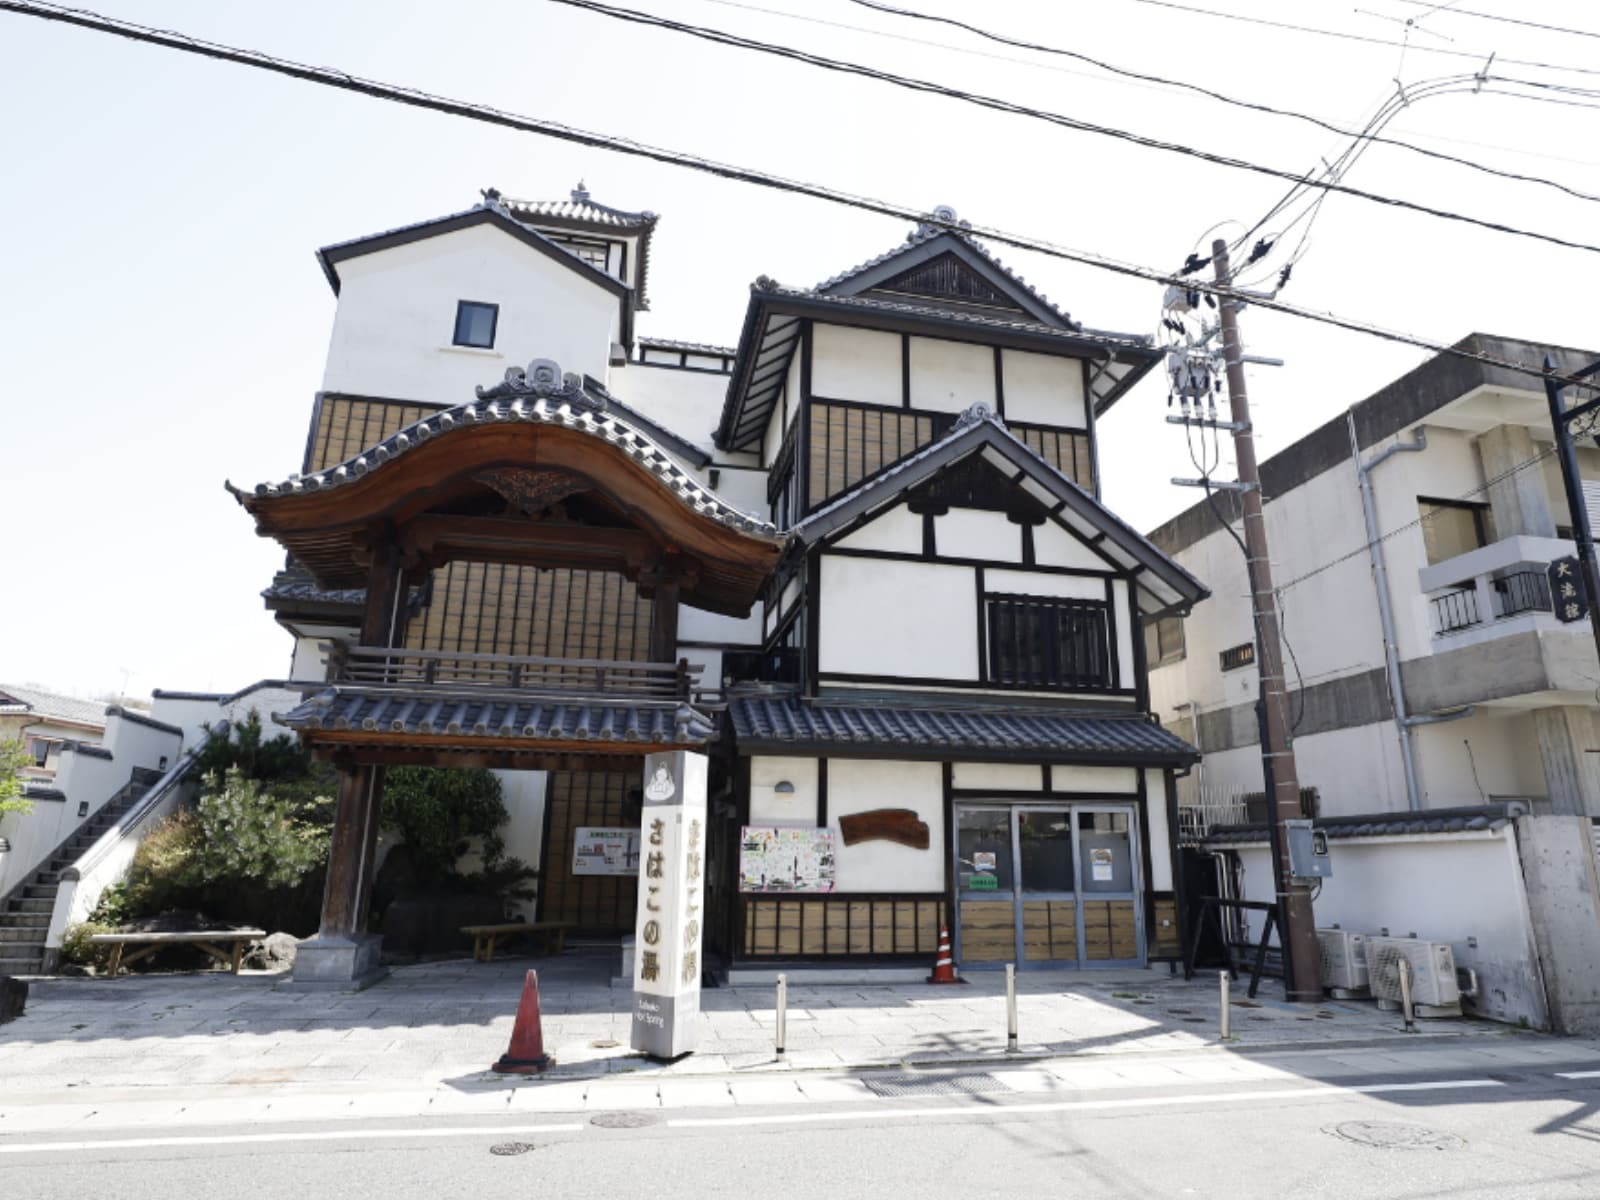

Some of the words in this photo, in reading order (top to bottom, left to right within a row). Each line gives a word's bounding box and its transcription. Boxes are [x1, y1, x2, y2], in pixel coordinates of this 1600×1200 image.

[641, 818, 665, 982] さはこの湯
